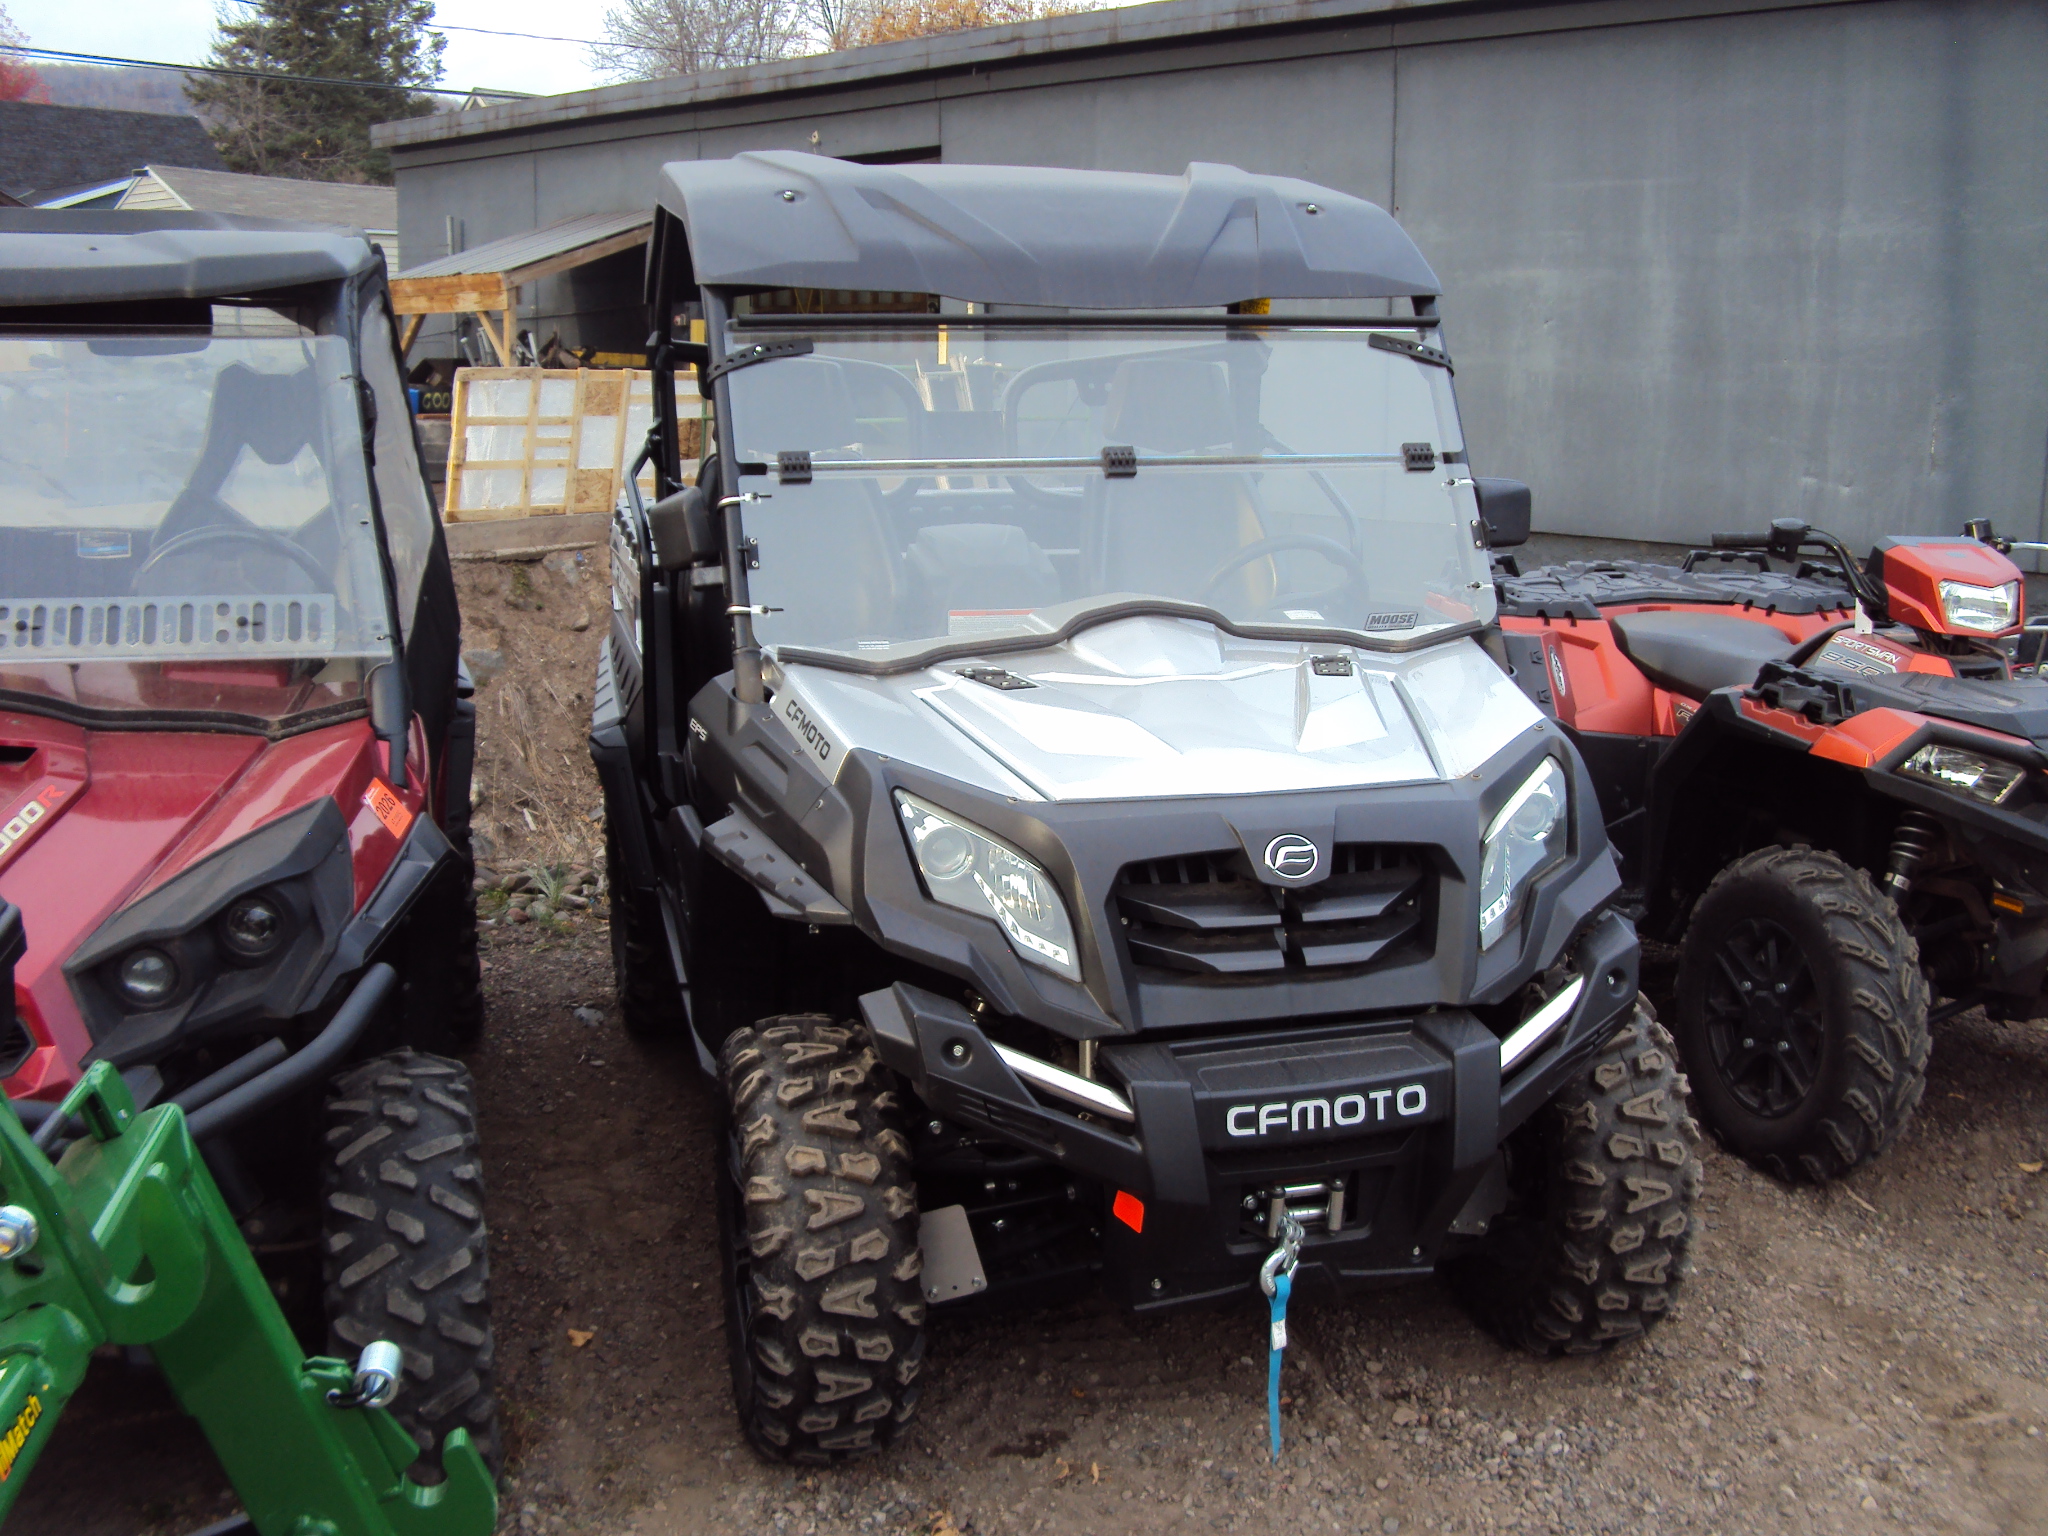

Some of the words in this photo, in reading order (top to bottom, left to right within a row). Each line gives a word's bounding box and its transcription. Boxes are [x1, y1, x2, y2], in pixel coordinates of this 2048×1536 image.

[1370, 613, 1415, 625] MOOSE
[1832, 635, 1900, 664] SPORTSMAN
[689, 717, 709, 742] EPS
[785, 699, 831, 761] CFMOTO
[375, 793, 396, 820] 2026
[1226, 1083, 1427, 1137] CFMOTO
